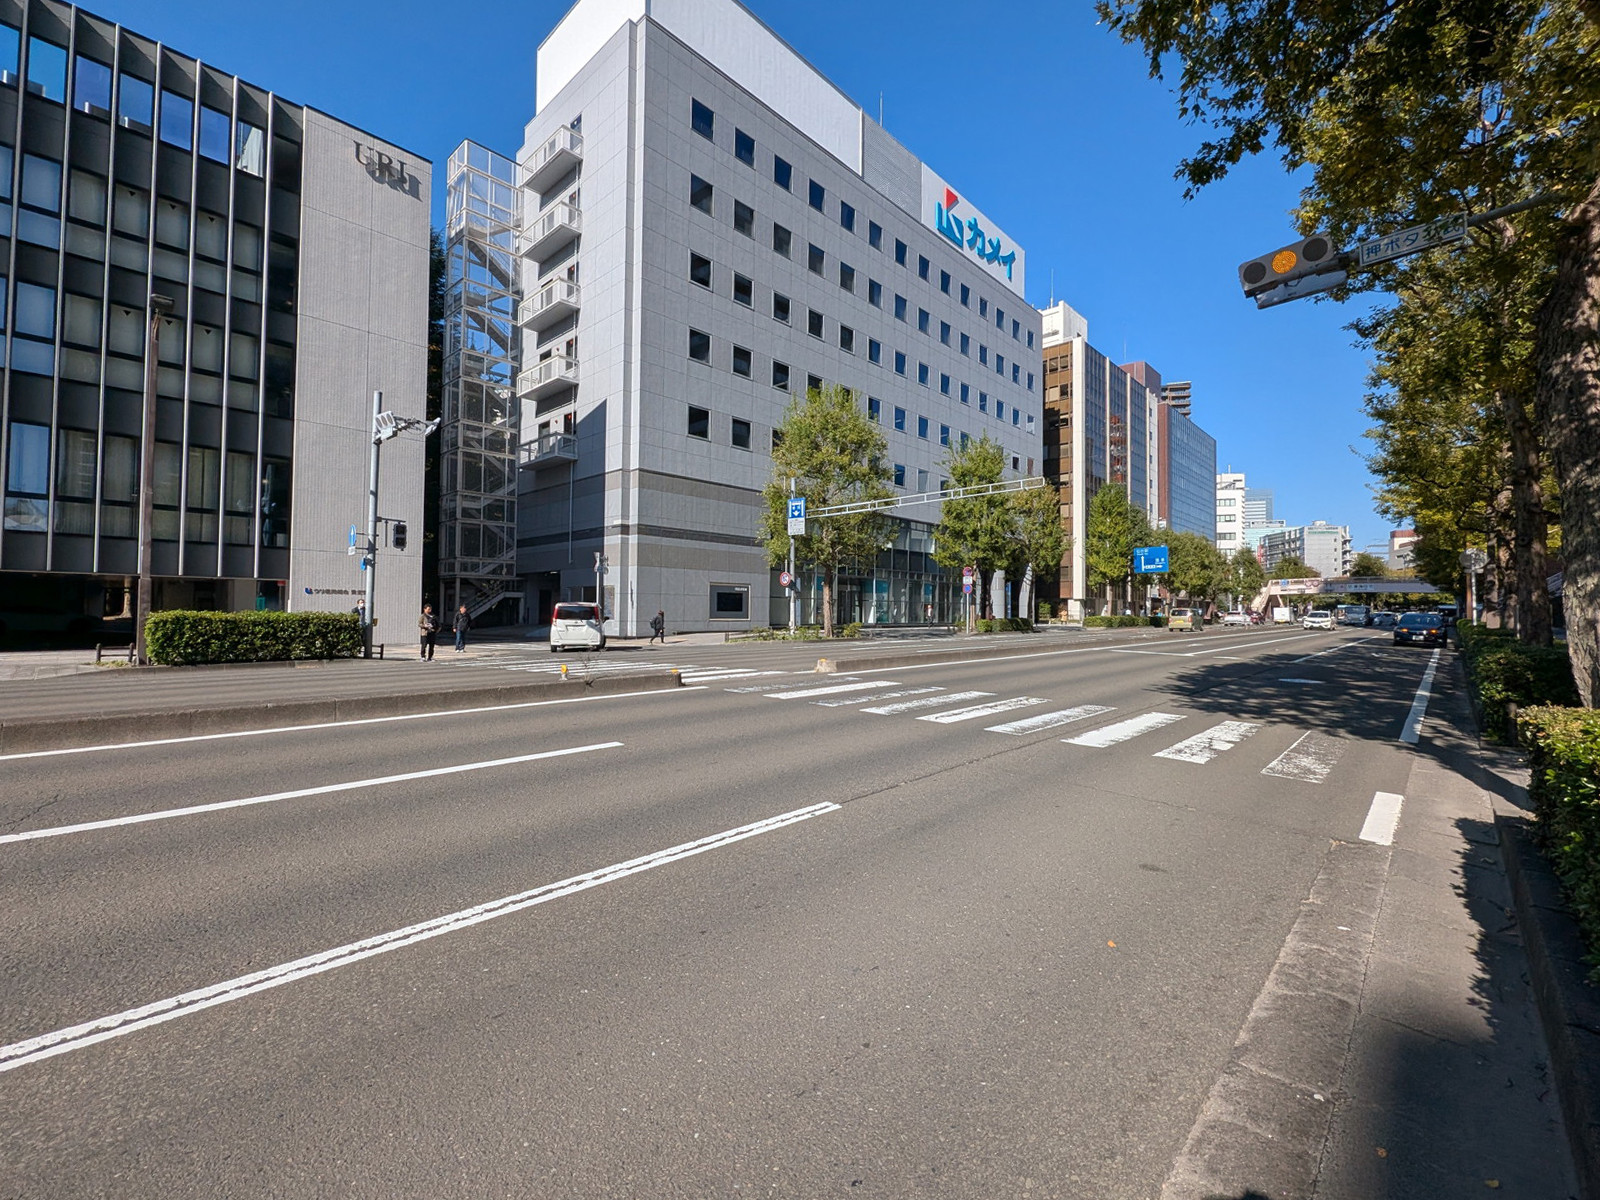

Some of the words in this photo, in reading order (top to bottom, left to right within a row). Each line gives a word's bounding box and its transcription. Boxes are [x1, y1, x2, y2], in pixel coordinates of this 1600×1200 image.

[353, 140, 408, 184] URI
[966, 216, 1016, 282] カメイ
